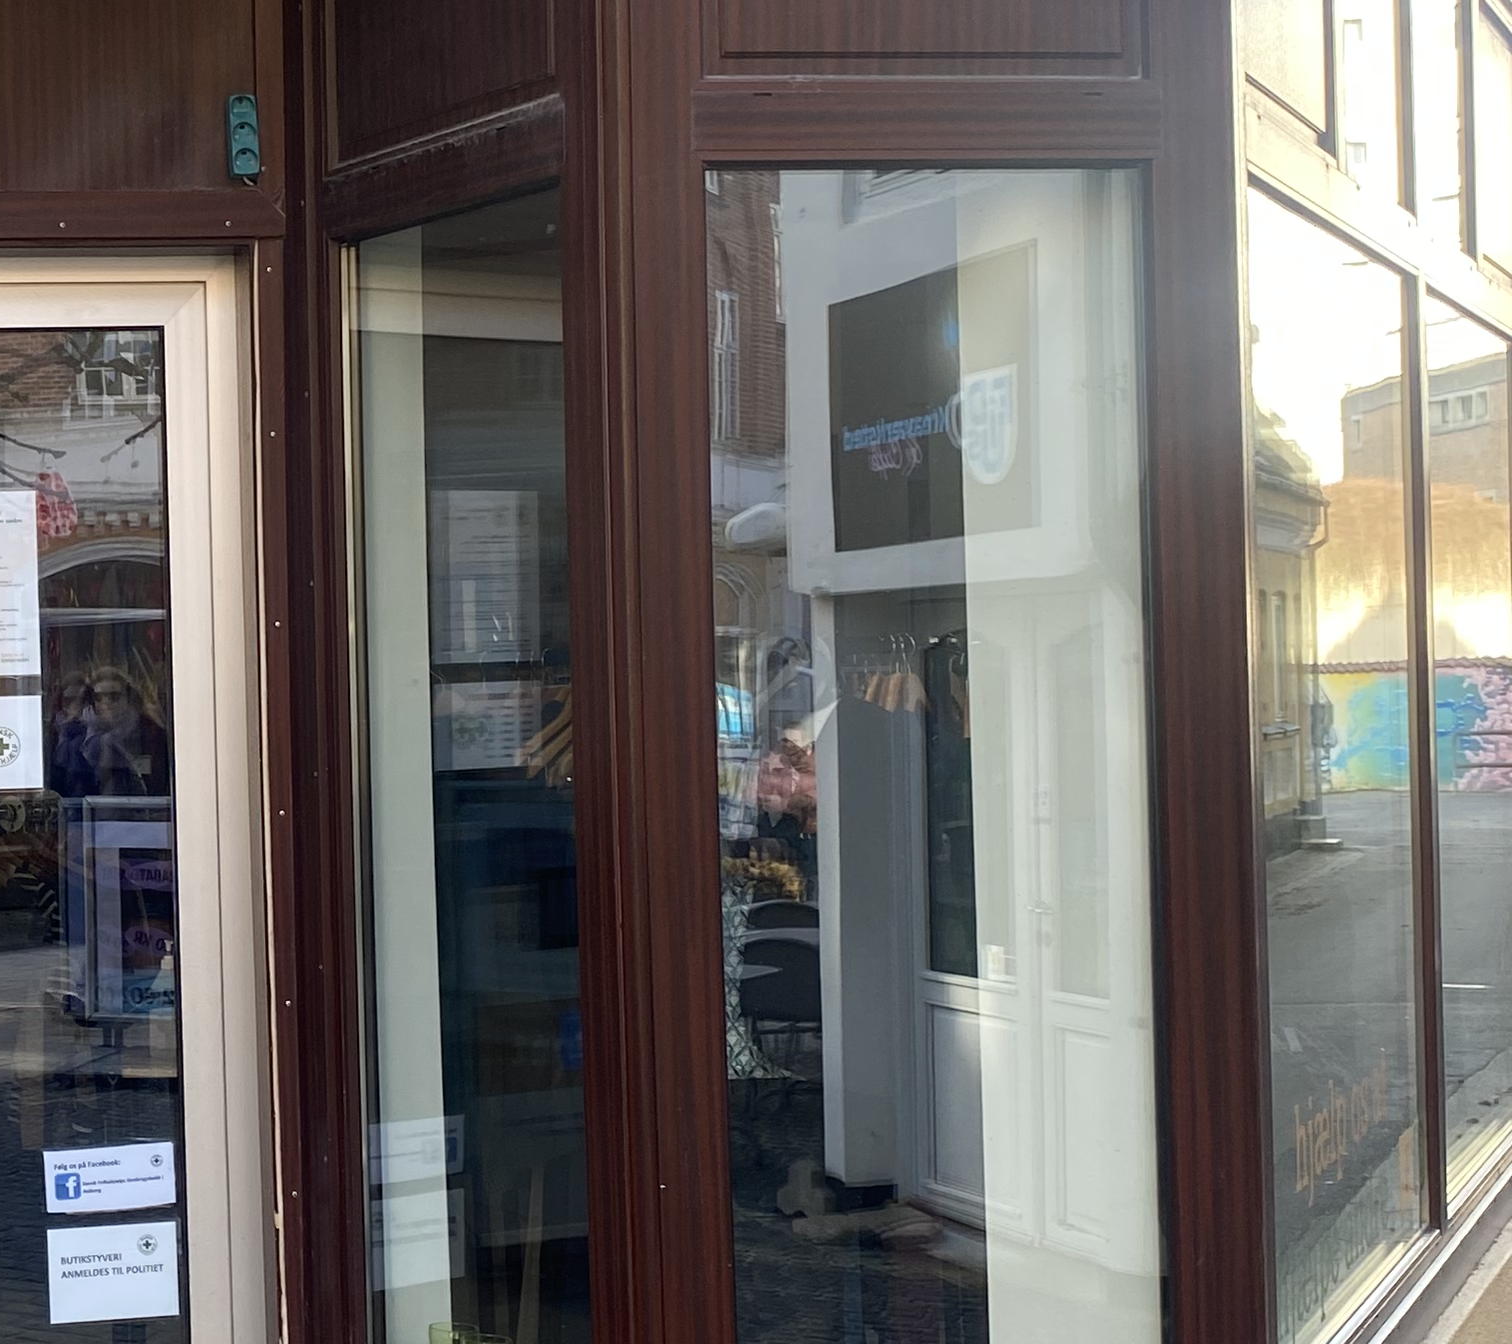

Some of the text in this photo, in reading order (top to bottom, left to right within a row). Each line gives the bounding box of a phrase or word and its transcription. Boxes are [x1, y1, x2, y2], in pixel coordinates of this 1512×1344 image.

[1294, 1079, 1348, 1209] hjælp
[54, 1163, 67, 1171] Følg
[78, 1162, 87, 1170] på
[88, 1159, 121, 1168] Facebook:
[61, 1253, 122, 1264] BUTIKSTYVERI
[61, 1264, 164, 1279] ANMELDES TIL POLITIET
